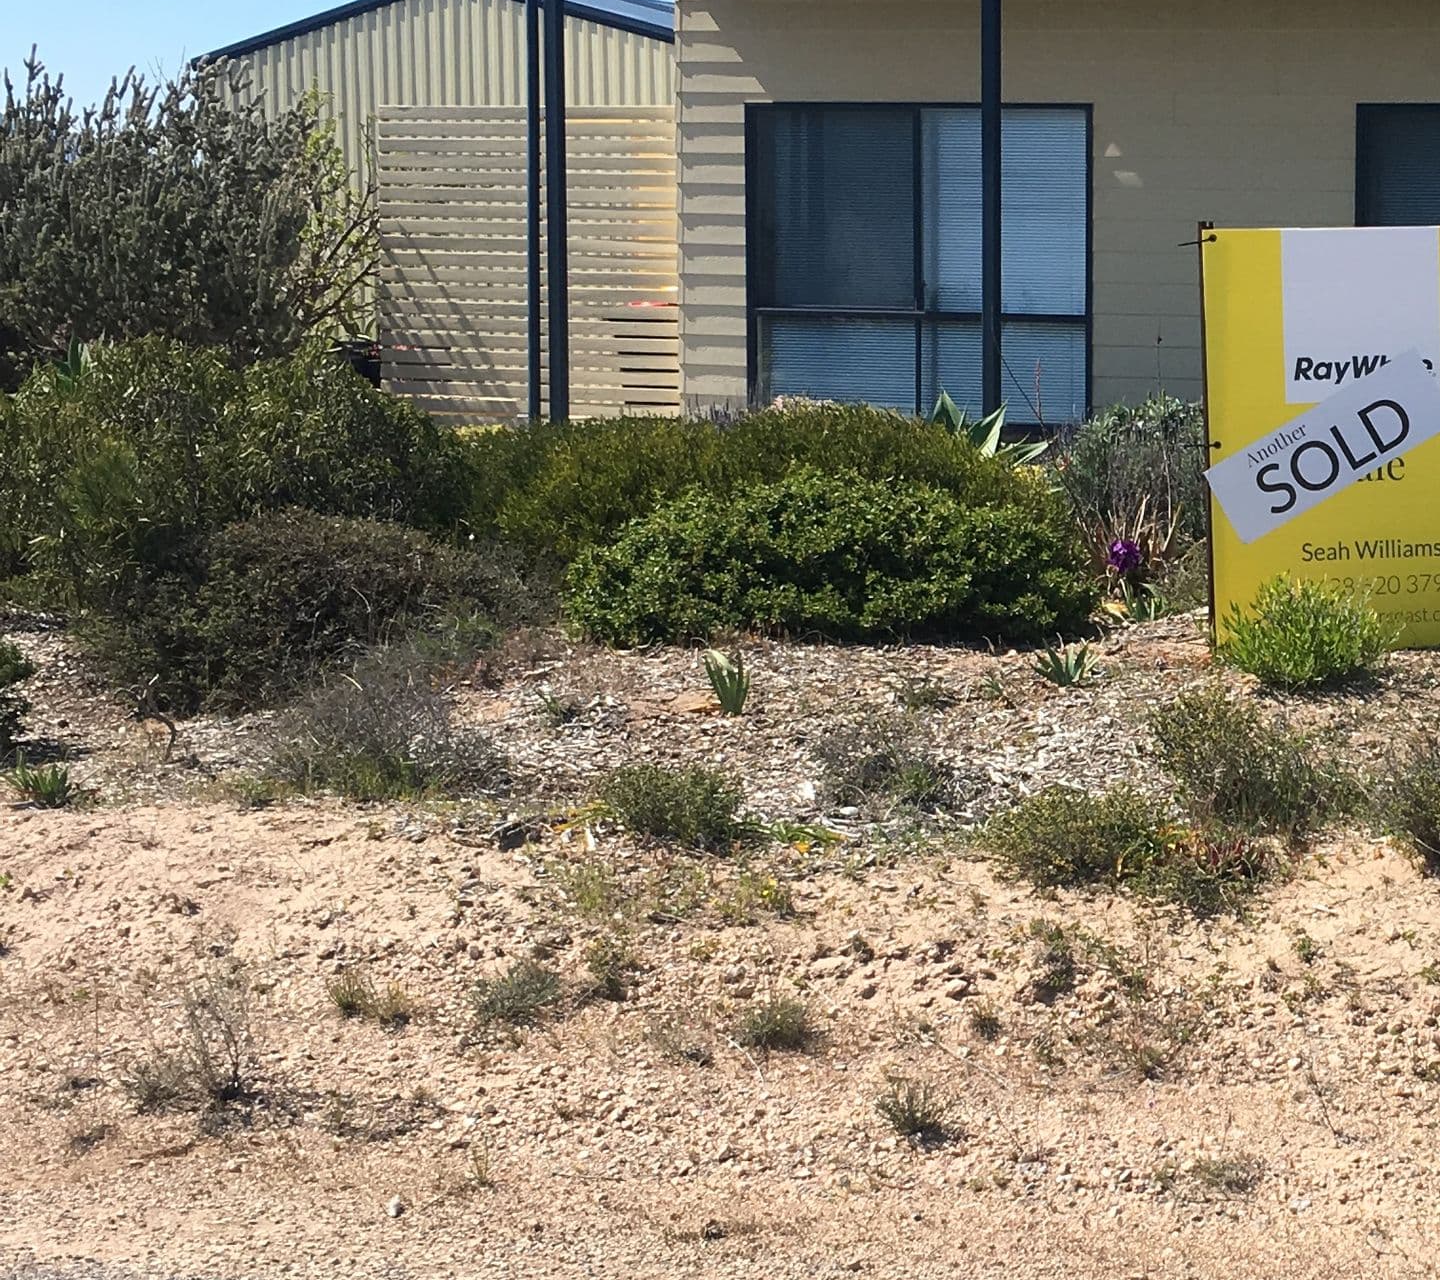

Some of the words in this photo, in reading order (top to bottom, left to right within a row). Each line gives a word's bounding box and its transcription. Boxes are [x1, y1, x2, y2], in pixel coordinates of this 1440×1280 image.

[1294, 355, 1433, 385] RayW
[1248, 424, 1306, 468] Another
[1256, 399, 1410, 514] SOLD
[1302, 541, 1350, 562] Seah
[1302, 577, 1355, 597] 28
